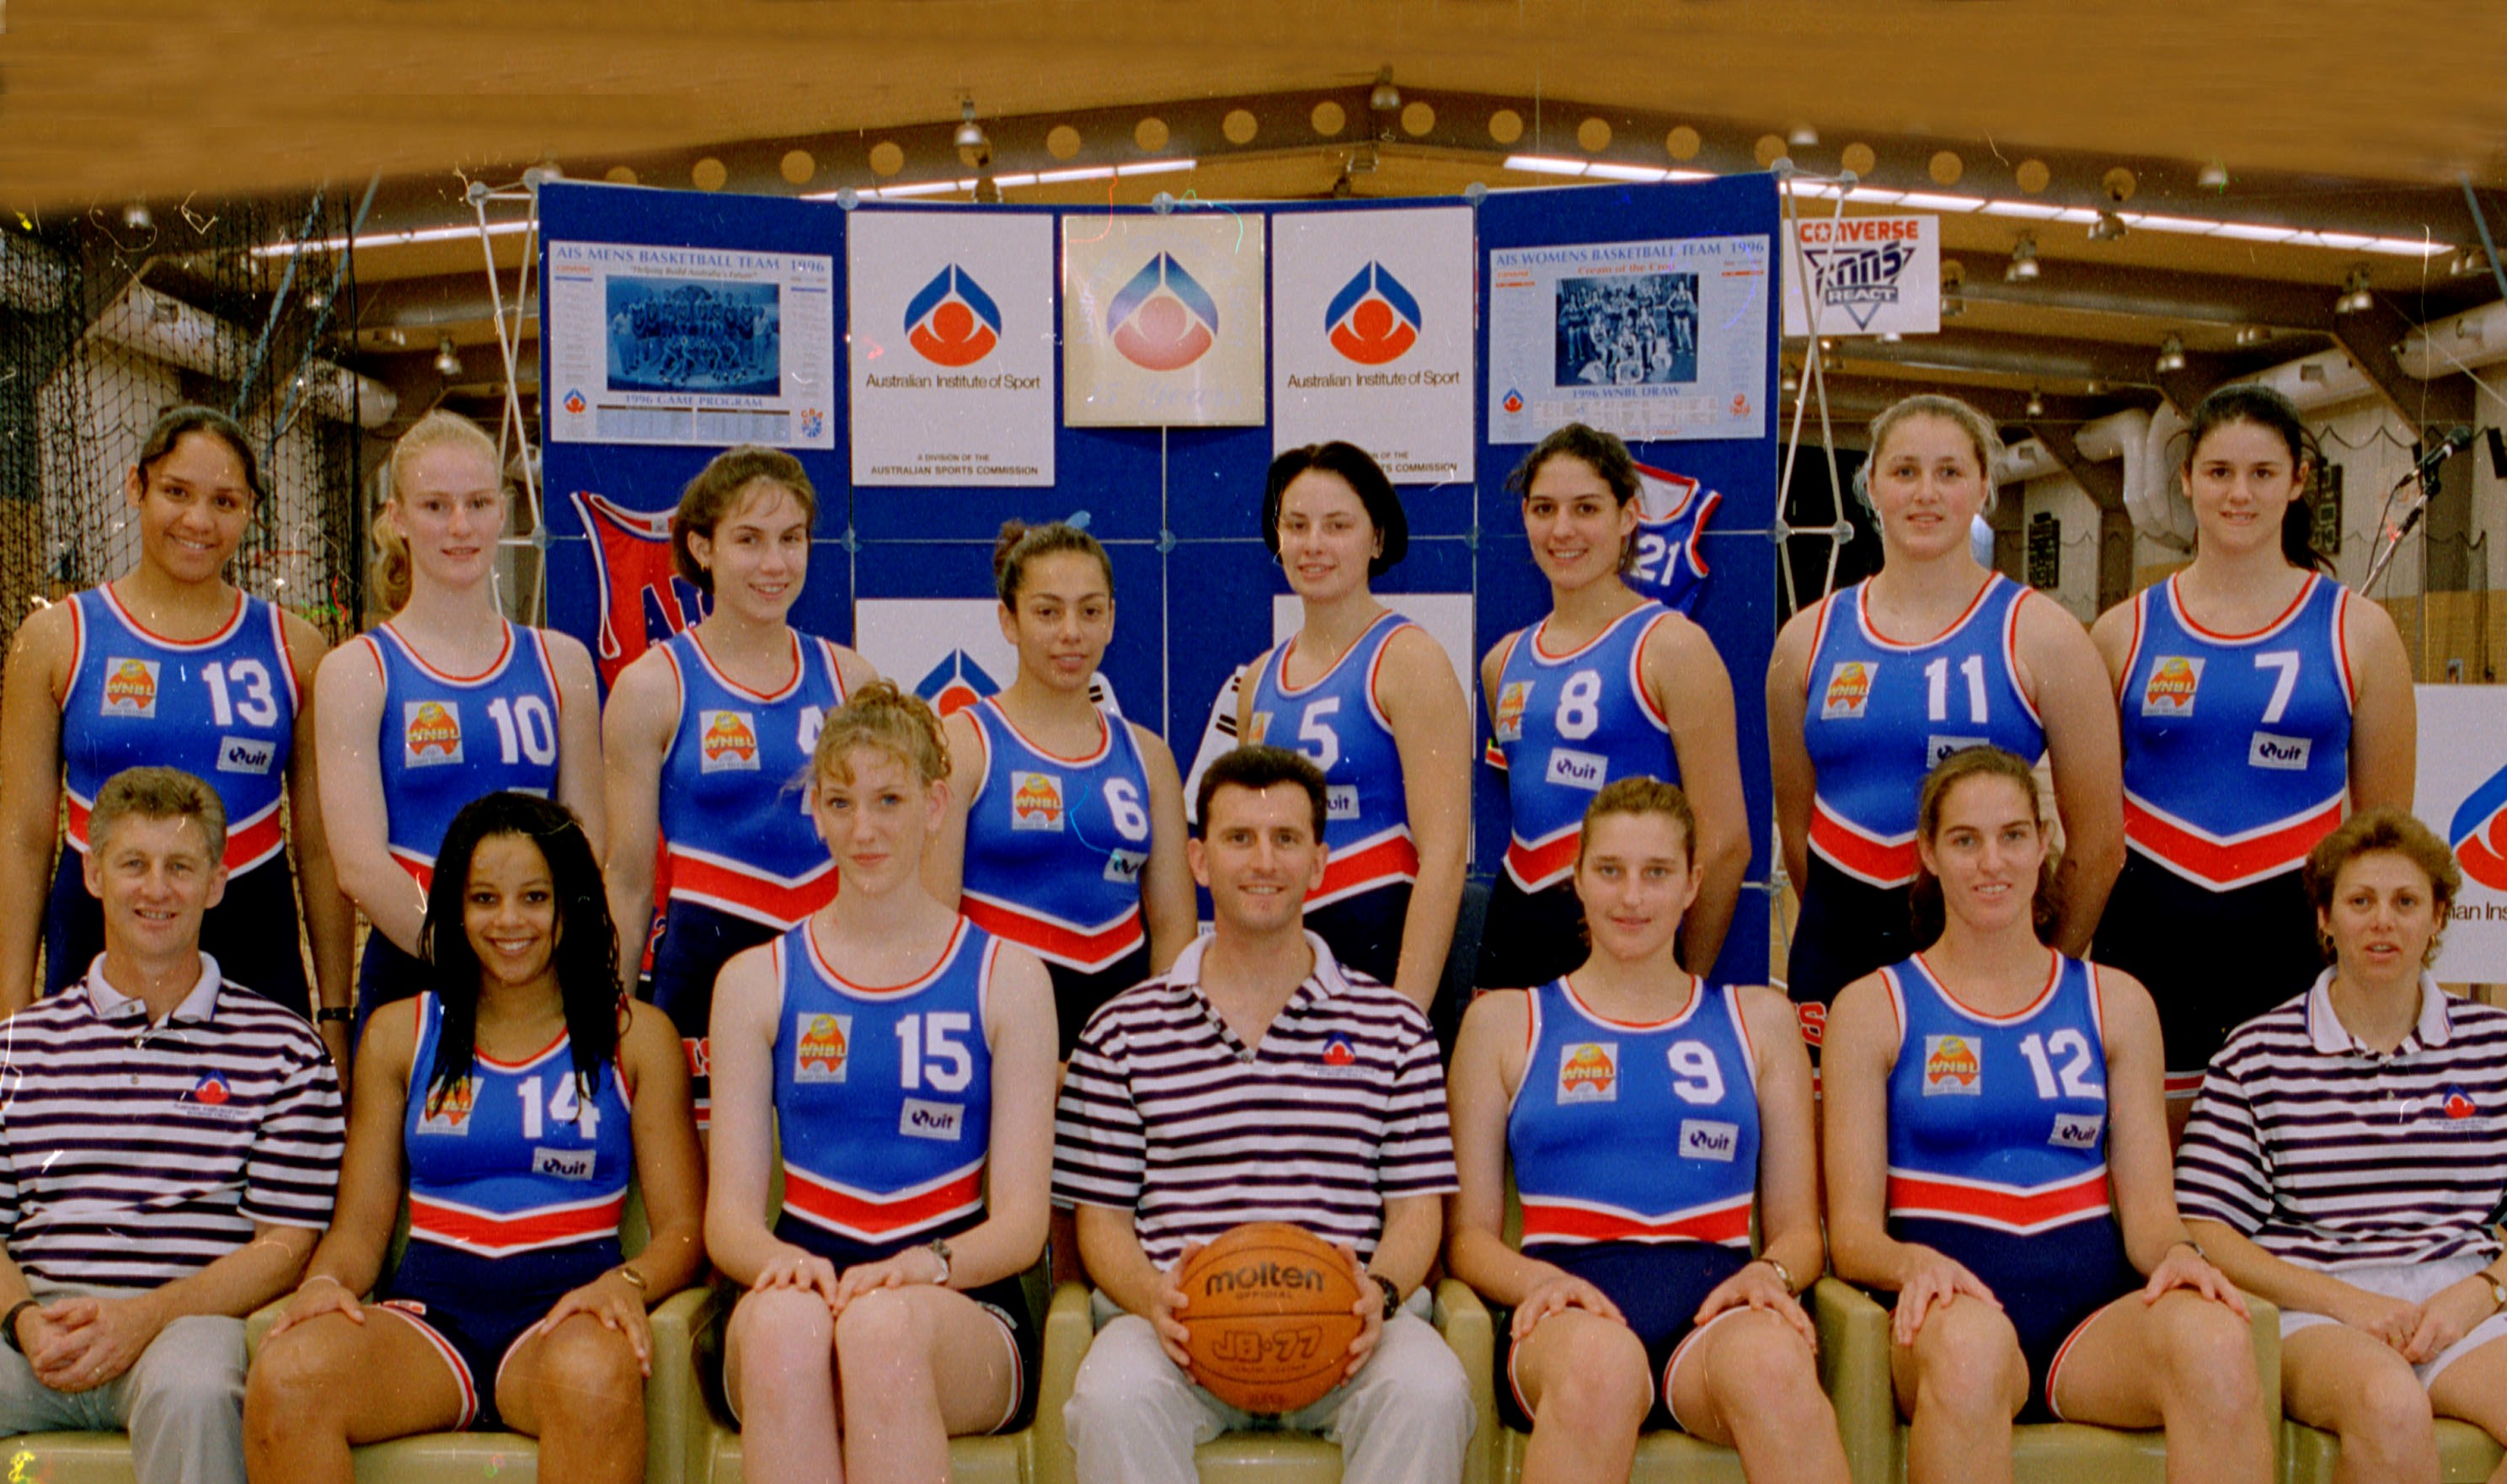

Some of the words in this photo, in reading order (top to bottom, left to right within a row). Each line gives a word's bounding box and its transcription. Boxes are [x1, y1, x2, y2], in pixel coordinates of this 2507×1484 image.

[1799, 220, 1919, 243] CONVERSE
[557, 246, 582, 259] AIS
[588, 248, 634, 263] MENS
[639, 250, 732, 268] BASKETBALL
[739, 255, 780, 270] TEAM
[791, 259, 825, 272] 1996
[1496, 254, 1517, 266] AIS
[1521, 248, 1588, 264] WOMENS
[1591, 245, 1674, 261] BASKETBALL
[1682, 243, 1721, 257] TEAM
[1732, 240, 1765, 254] 1996
[1578, 265, 1612, 276] Cream
[1616, 264, 1627, 274] of
[1629, 262, 1645, 273] the
[866, 373, 932, 388] Australian
[936, 374, 986, 388] Institute
[989, 373, 1002, 388] of
[1003, 373, 1041, 391] Sport
[1287, 373, 1351, 388] Australian
[1356, 372, 1406, 386] Institute
[1409, 371, 1421, 385] of
[1424, 370, 1460, 387] Sport
[626, 394, 653, 405] 1996
[657, 395, 694, 406] GAME
[698, 397, 763, 408] PROGRAM
[1572, 388, 1599, 399] 1996
[1602, 387, 1638, 398] WNBL
[1642, 385, 1681, 397] DRAW
[925, 453, 960, 462] DIVISION
[961, 453, 971, 462] OF
[975, 453, 990, 462] THE
[1380, 451, 1392, 460] OF
[1394, 451, 1409, 460] THE
[871, 466, 932, 475] AUSTRALIAN
[935, 466, 973, 475] SPORTS
[976, 466, 1039, 475] COMMISSION
[1395, 462, 1457, 472] COMMISSION
[1629, 533, 1681, 586] 21
[107, 682, 155, 697] WNBL
[201, 658, 279, 728] 13
[1828, 685, 1869, 697] WNBL
[1925, 654, 1988, 723] 11
[2147, 681, 2196, 694] WNBL
[2254, 650, 2300, 723] 7
[1555, 670, 1601, 740] 8
[406, 726, 461, 743] WNBL
[488, 694, 557, 766] 10
[1297, 697, 1340, 772] 5
[703, 734, 756, 749] WNBL
[2259, 741, 2302, 761] Quit
[229, 746, 268, 766] Quit
[1557, 758, 1597, 780] Quit
[1016, 796, 1062, 810] WNBL
[1104, 777, 1148, 841] 6
[799, 1042, 847, 1058] WNBL
[895, 1012, 973, 1092] 15
[1562, 1066, 1615, 1081] WNBL
[1667, 1040, 1725, 1105] 9
[1927, 1061, 1980, 1076] WNBL
[2019, 1028, 2105, 1100] 12
[517, 1072, 601, 1140] 14
[911, 1109, 954, 1129] Quit
[1690, 1129, 1730, 1150] Quit
[2061, 1124, 2096, 1141] Quit
[543, 1157, 587, 1176] Quit
[1205, 1262, 1324, 1298] molten
